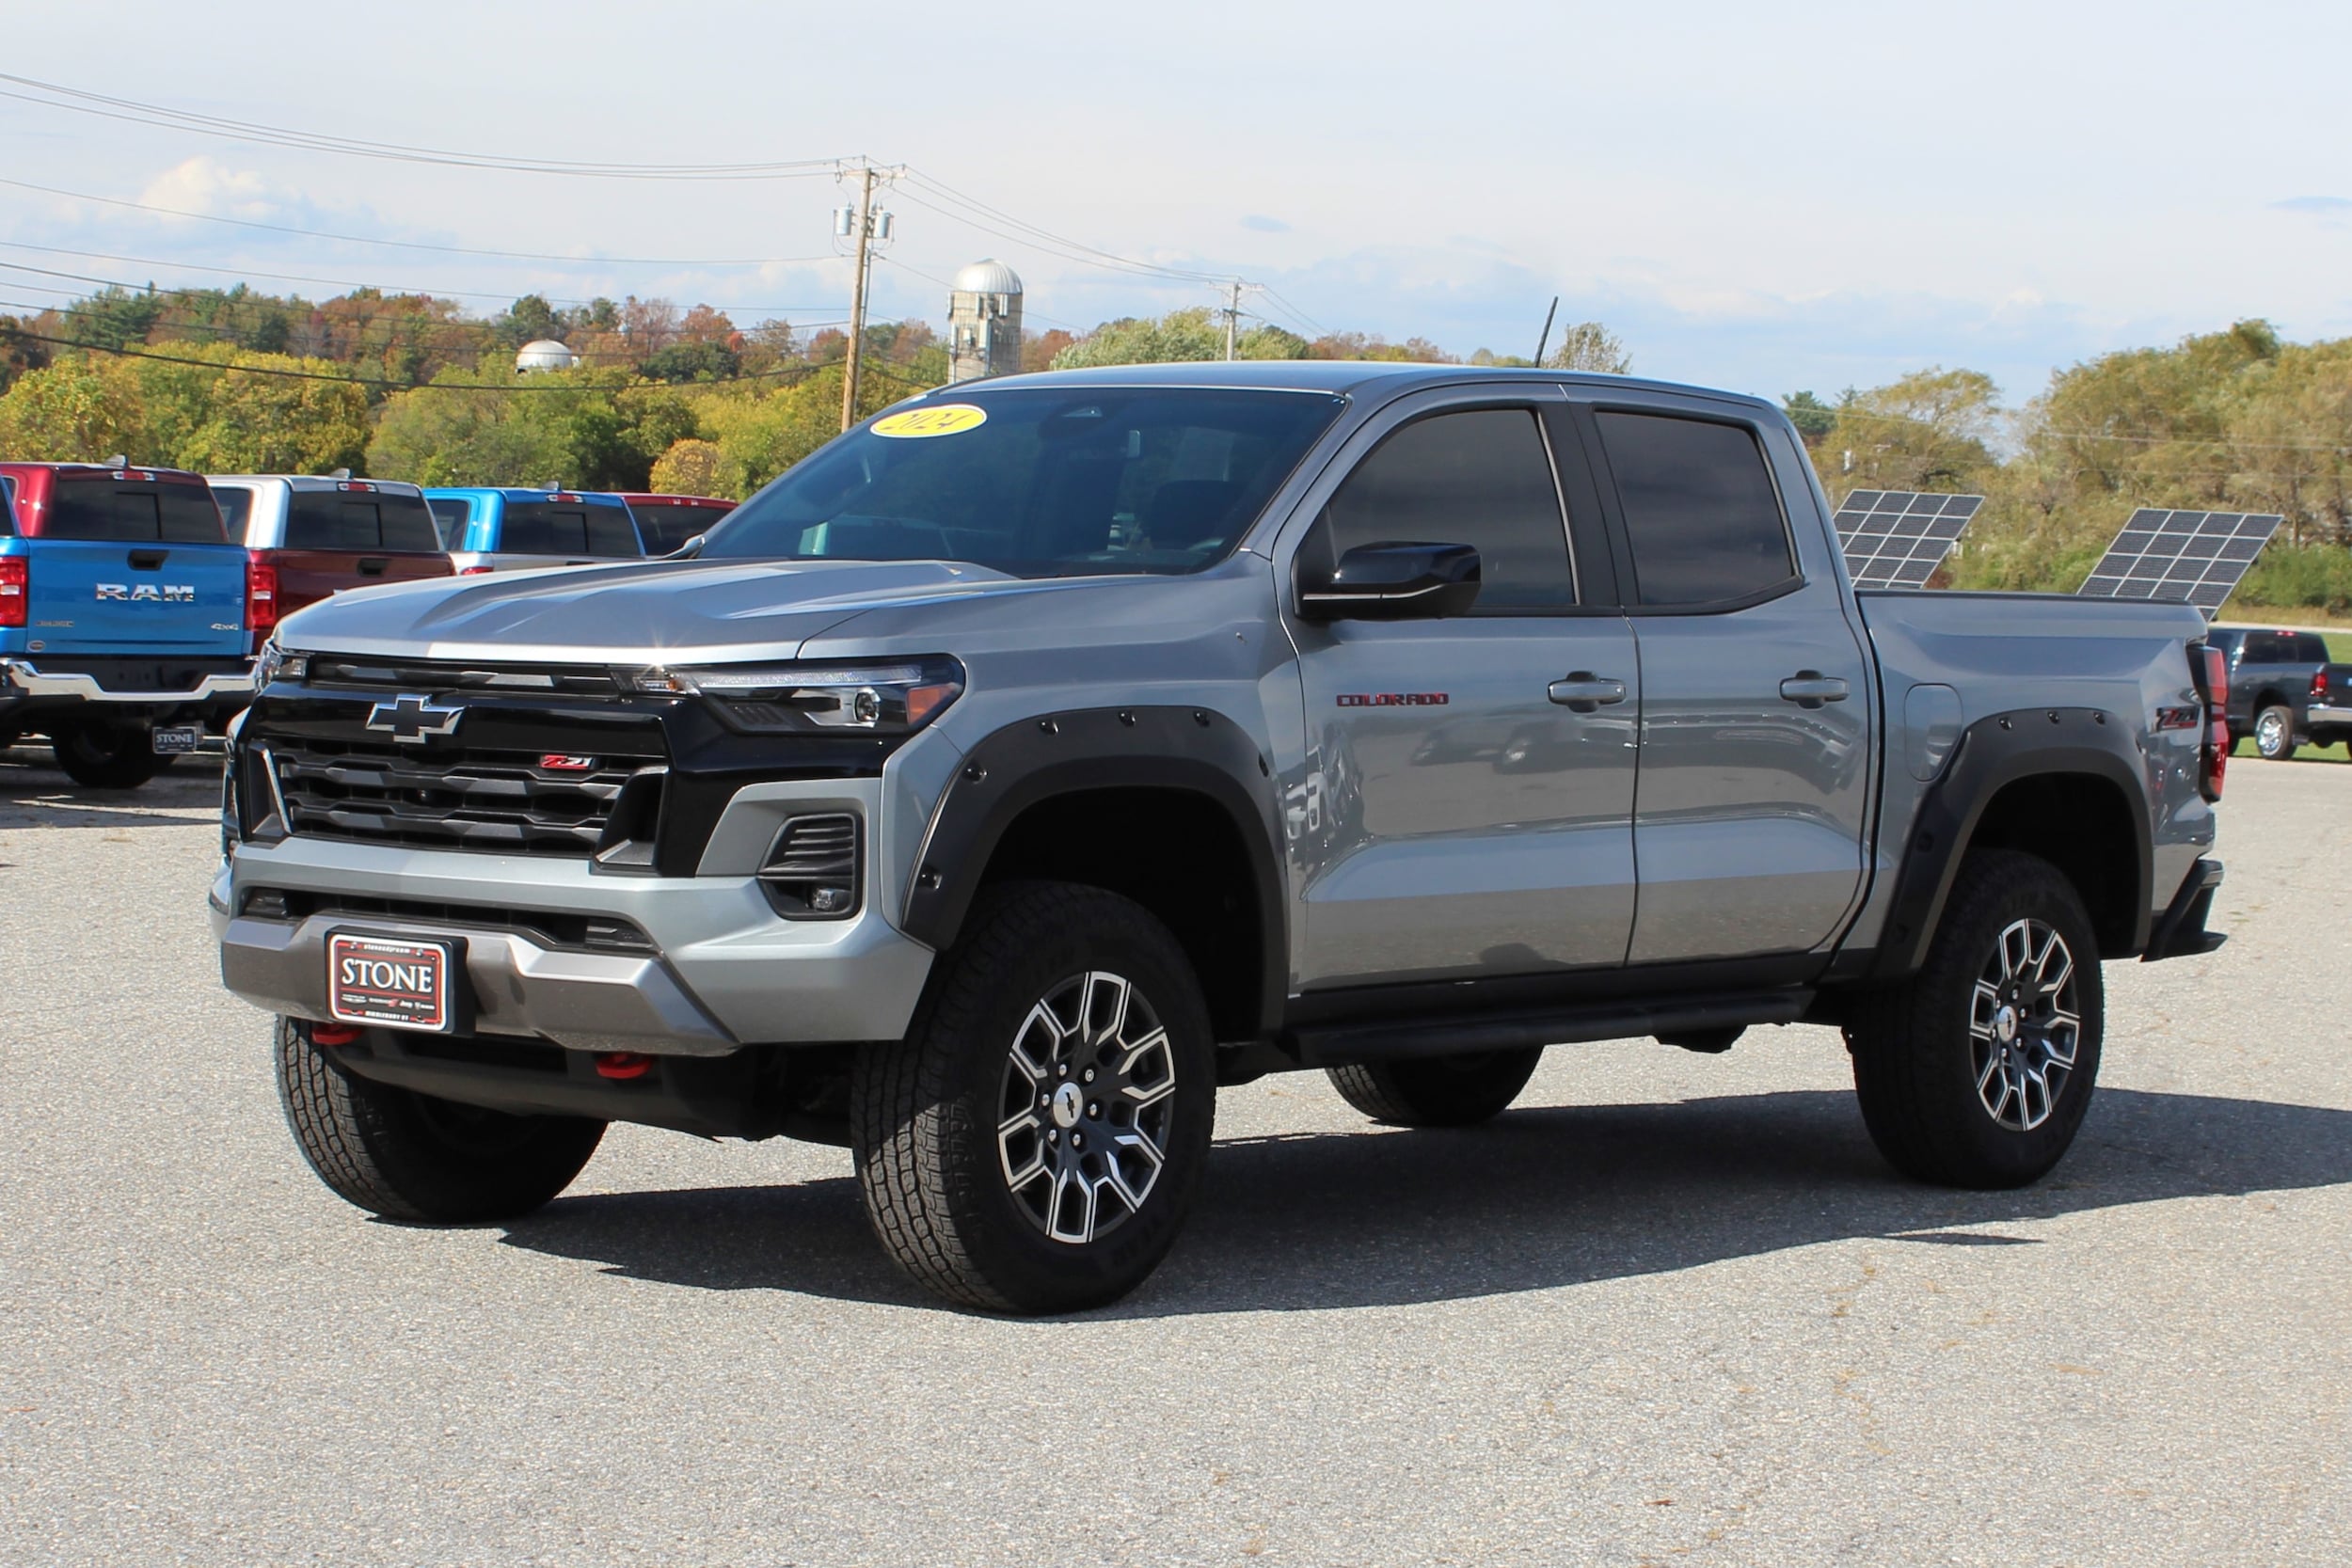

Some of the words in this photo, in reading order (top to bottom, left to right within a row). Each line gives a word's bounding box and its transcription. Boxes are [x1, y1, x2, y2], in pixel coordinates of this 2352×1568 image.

[879, 412, 974, 430] 2024
[97, 583, 194, 601] RAM
[1336, 692, 1449, 706] COLORADO
[156, 733, 193, 743] STONE
[541, 754, 594, 769] Z71
[342, 958, 432, 992] STONE
